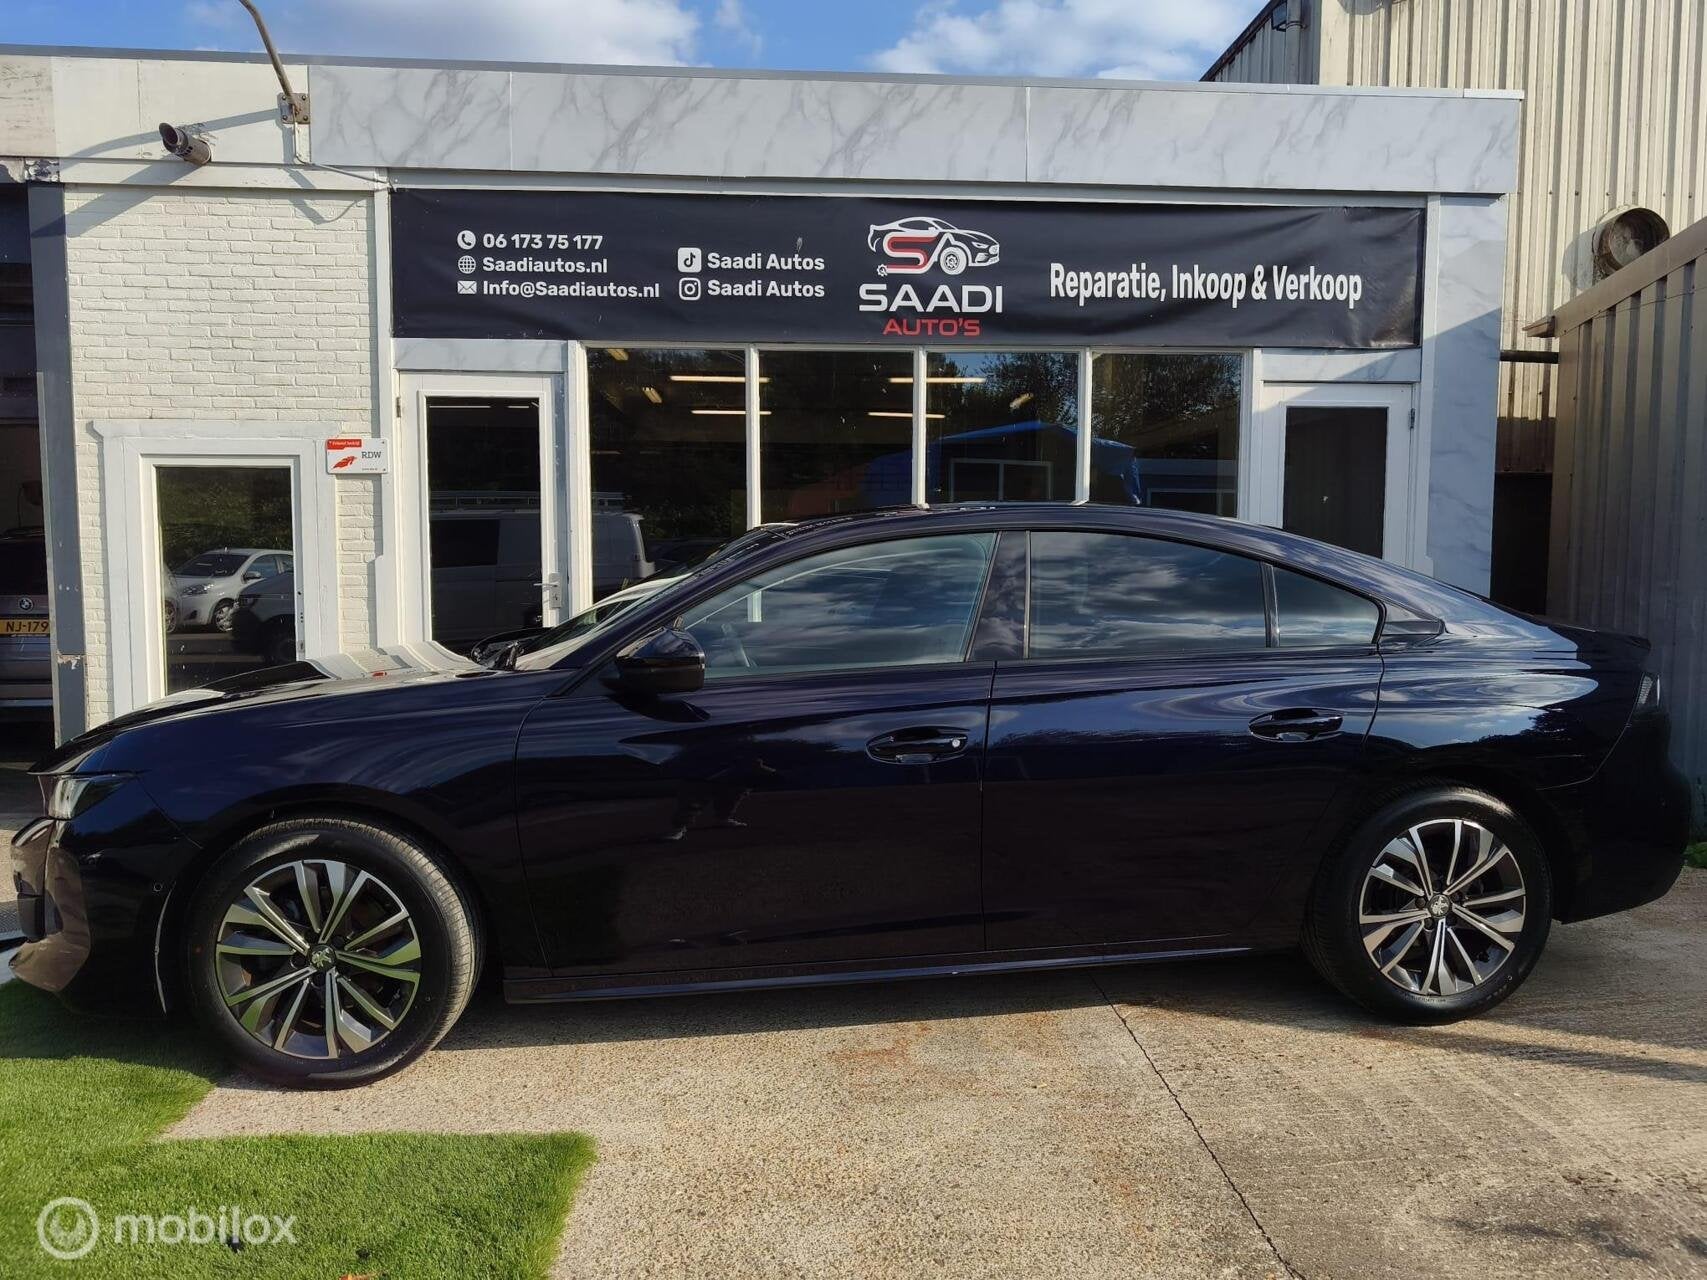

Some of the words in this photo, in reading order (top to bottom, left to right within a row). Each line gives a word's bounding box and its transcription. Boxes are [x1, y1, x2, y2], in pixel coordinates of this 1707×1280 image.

[482, 233, 507, 249] 06
[511, 234, 543, 249] 173
[547, 234, 569, 249] 75
[573, 235, 603, 250] 177
[482, 257, 608, 273] Saadiautos.nl
[707, 252, 762, 269] Saadi
[766, 253, 825, 270] Autos
[483, 280, 660, 298] Info@Saadiautos.nl
[707, 279, 762, 296] Saadi
[766, 280, 825, 297] Autos
[1050, 263, 1166, 306] Reparatie,
[1172, 264, 1247, 308] Inkoop
[1251, 264, 1267, 300] &
[1272, 265, 1362, 309] Verkoop
[859, 283, 1003, 313] SAADI
[882, 317, 981, 336] AUTO'S
[361, 451, 381, 459] RDW
[6, 621, 49, 632] NJ-179
